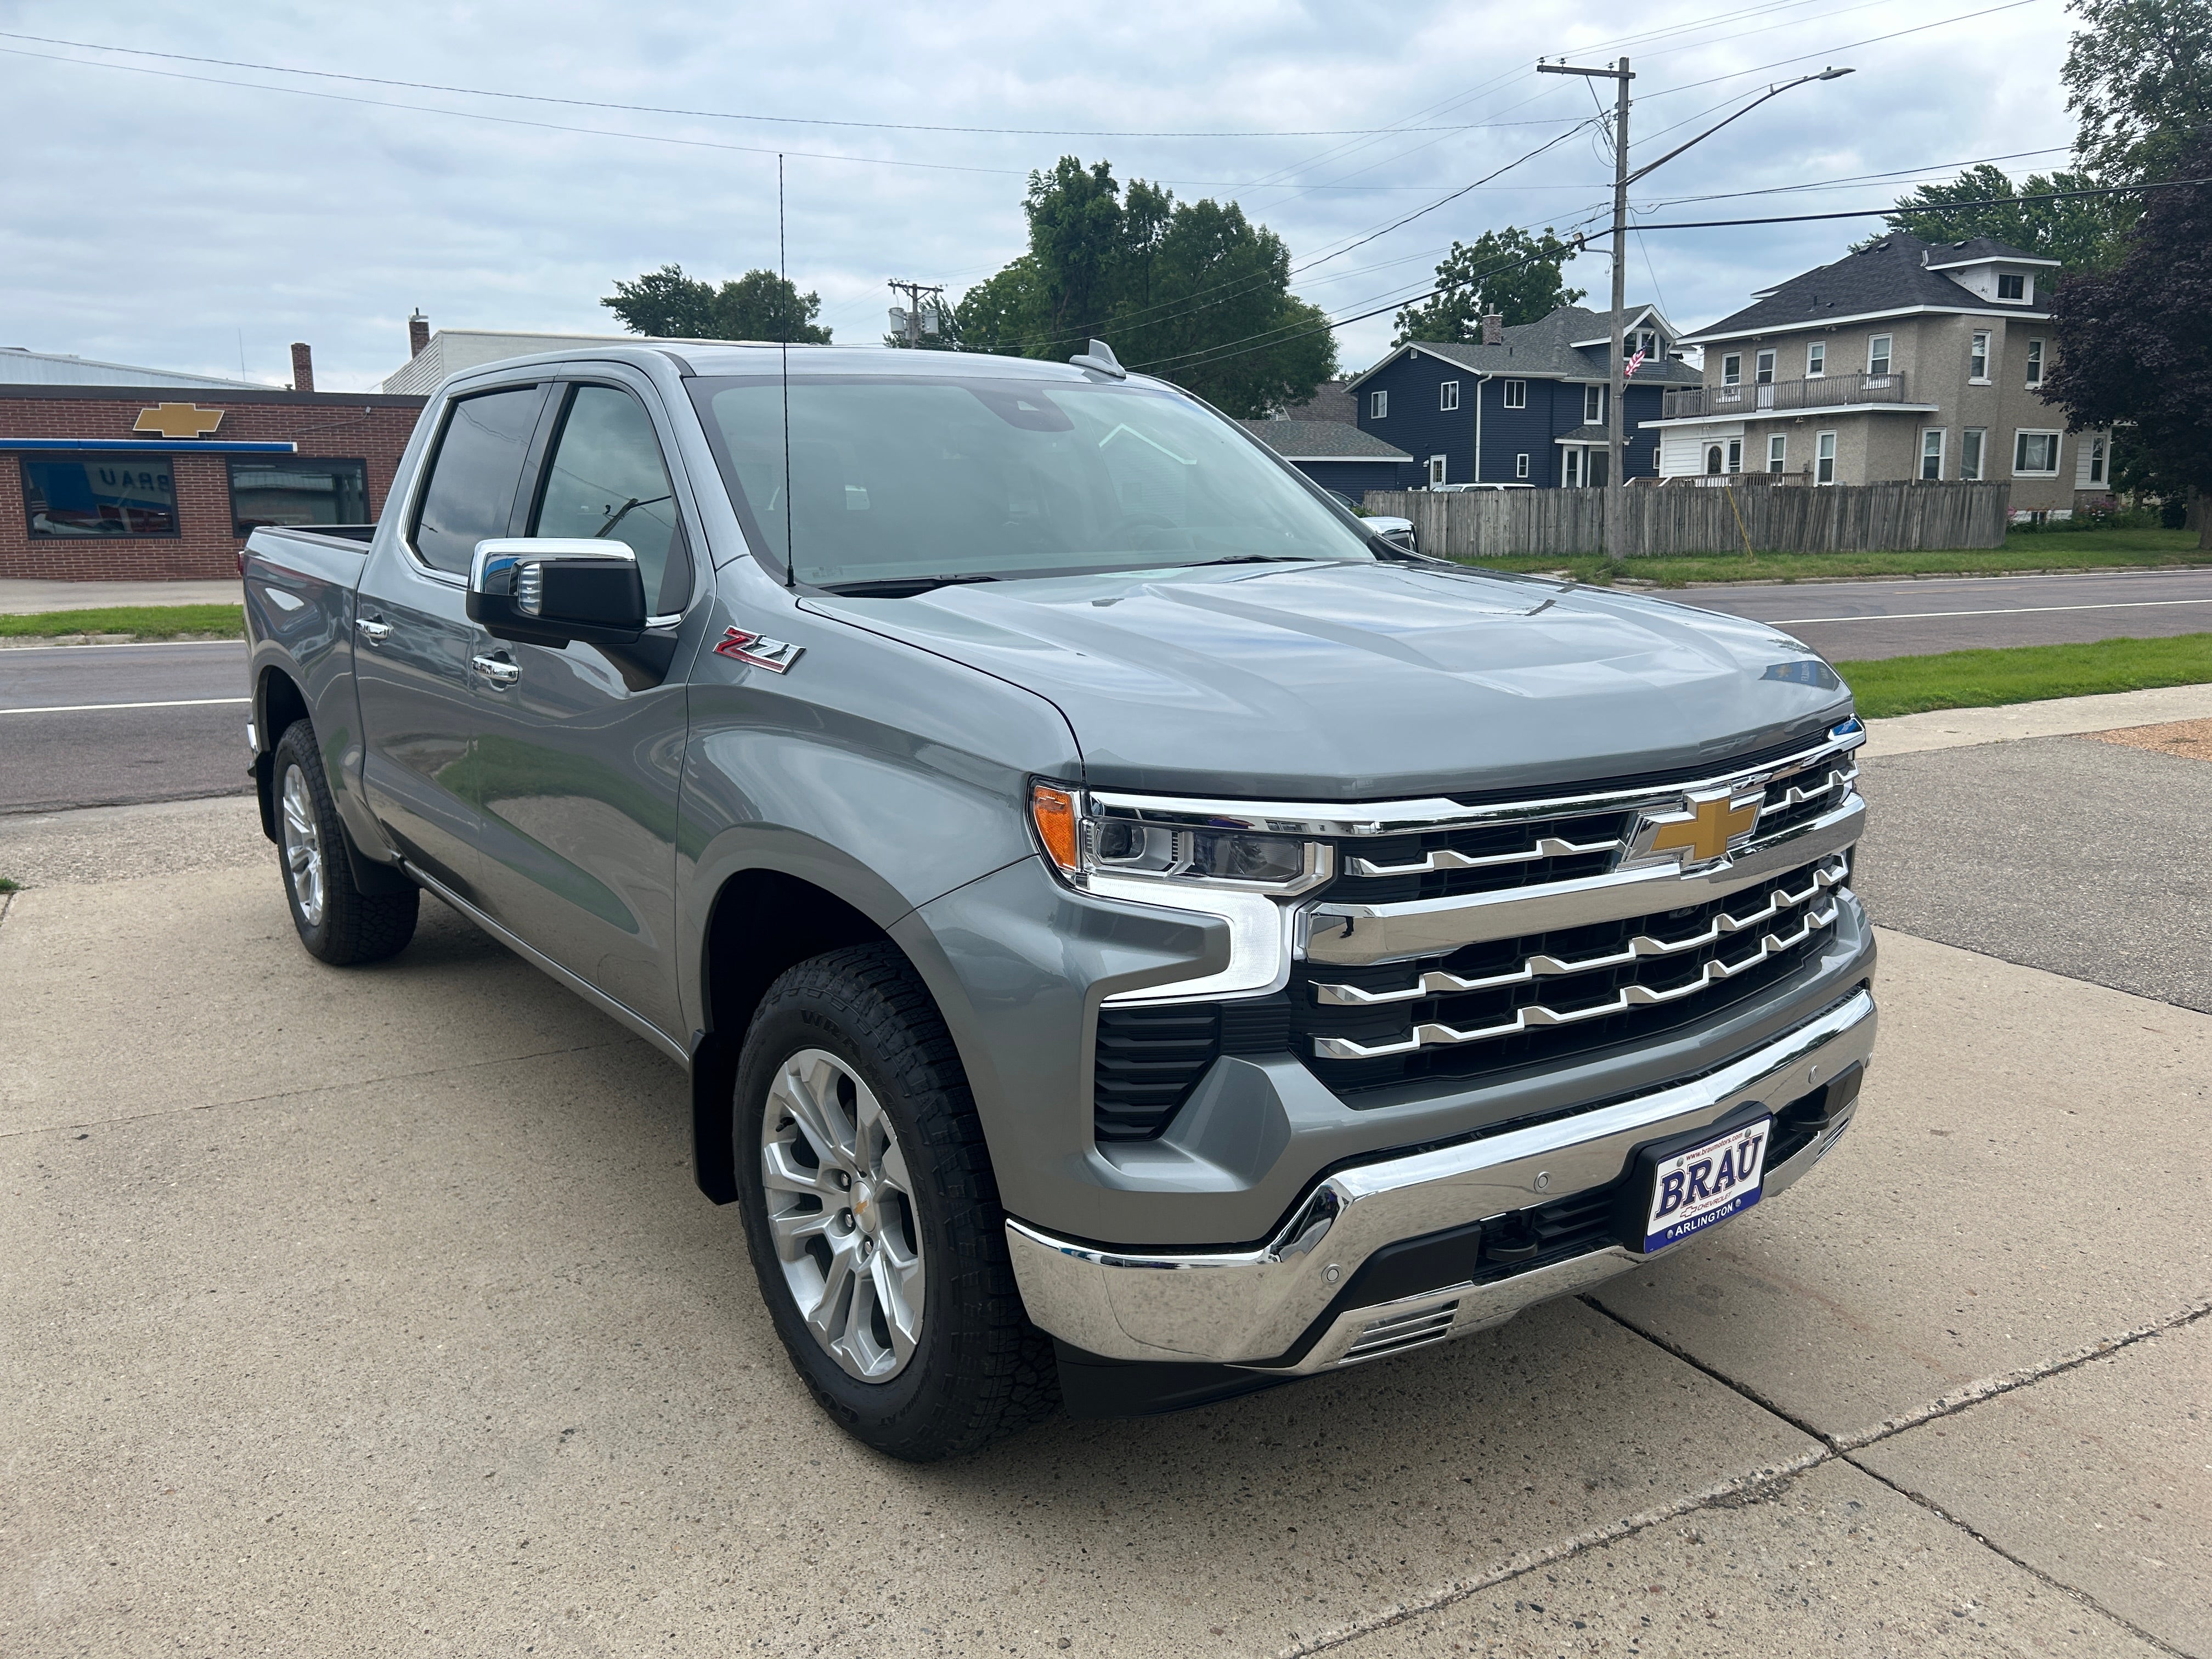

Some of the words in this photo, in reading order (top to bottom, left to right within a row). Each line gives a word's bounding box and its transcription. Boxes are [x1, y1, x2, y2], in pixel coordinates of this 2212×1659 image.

[712, 625, 806, 675] Z71
[1686, 1132, 1743, 1160] www.braumotors.com
[1655, 1132, 1764, 1220] BRAU
[1675, 1201, 1734, 1236] ARLINGTON
[1697, 1191, 1733, 1211] CHEVROLET
